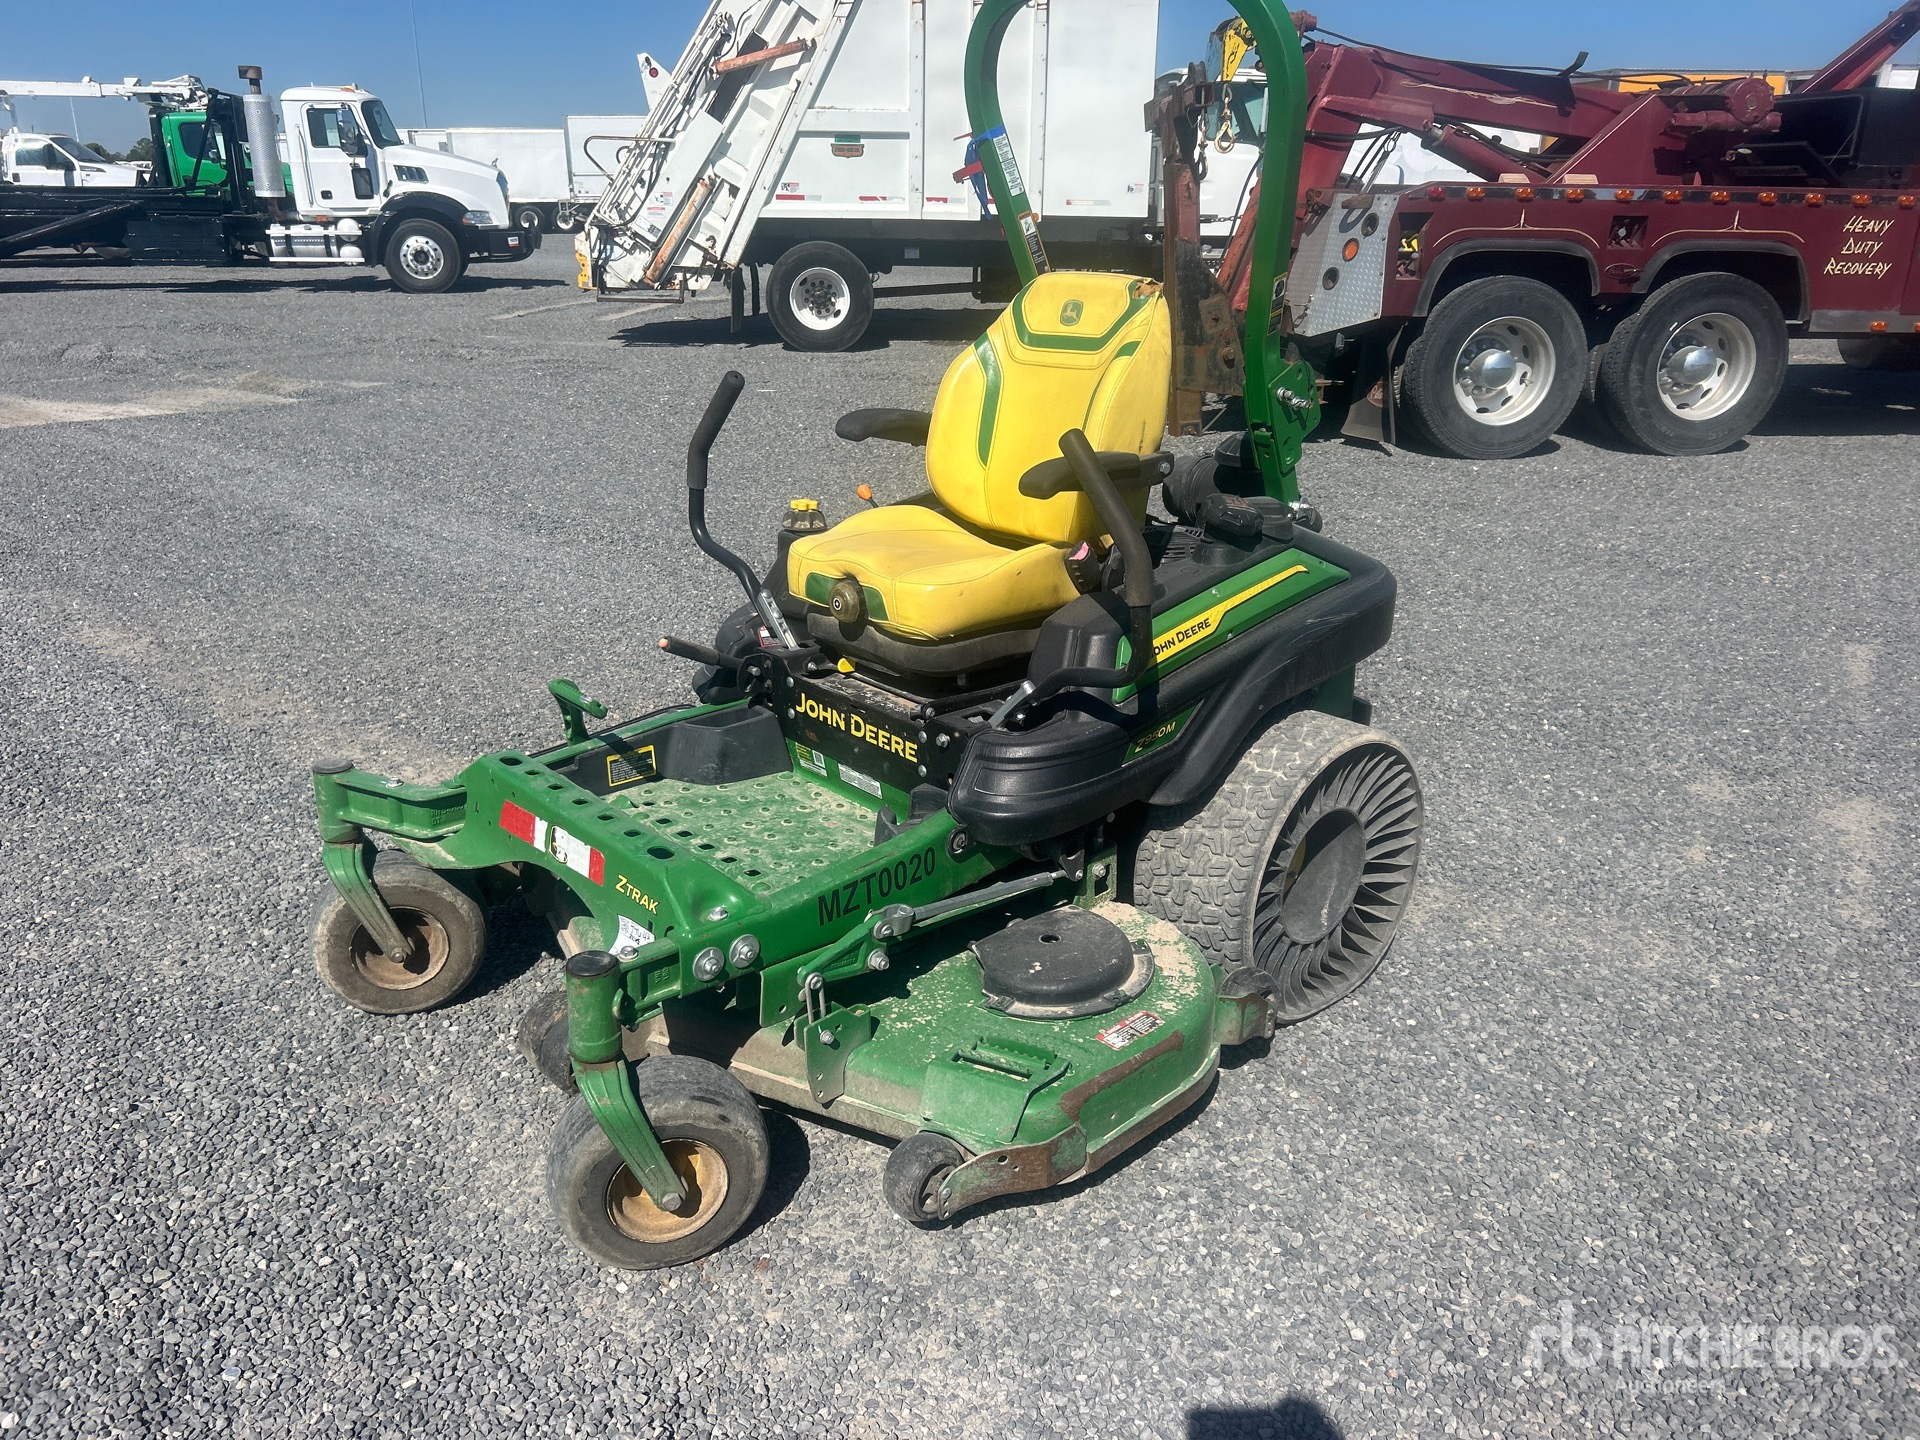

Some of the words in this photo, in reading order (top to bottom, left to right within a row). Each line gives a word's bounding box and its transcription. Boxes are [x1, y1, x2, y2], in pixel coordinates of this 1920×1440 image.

[1842, 215, 1895, 237] HEAVY
[1840, 237, 1884, 258] DUTY
[1823, 257, 1892, 279] RECOVERY
[1153, 637, 1176, 656] OHN
[1176, 617, 1212, 643] DEERE
[795, 692, 846, 732] JOHN
[850, 713, 918, 763] DEERE
[615, 874, 659, 915] ZTRAK
[817, 846, 936, 927] MZT0020
